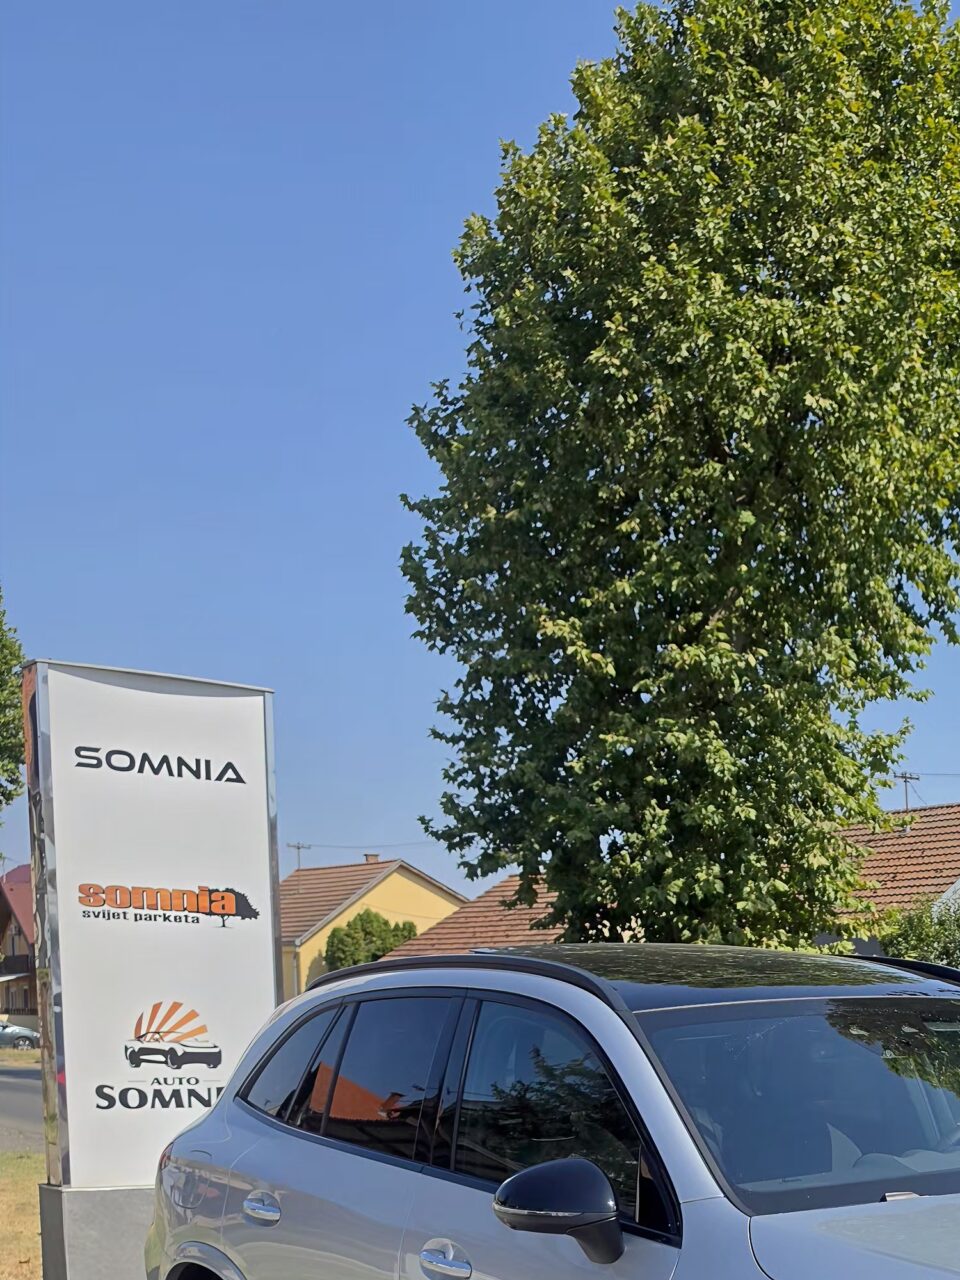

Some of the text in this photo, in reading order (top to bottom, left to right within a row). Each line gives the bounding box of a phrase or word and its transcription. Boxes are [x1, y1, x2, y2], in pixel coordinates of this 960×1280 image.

[74, 745, 247, 785] SOMNIA
[78, 883, 237, 915] somnia
[82, 909, 200, 924] svijet parketa
[150, 1076, 200, 1086] AUTO
[95, 1084, 225, 1110] SOMN
